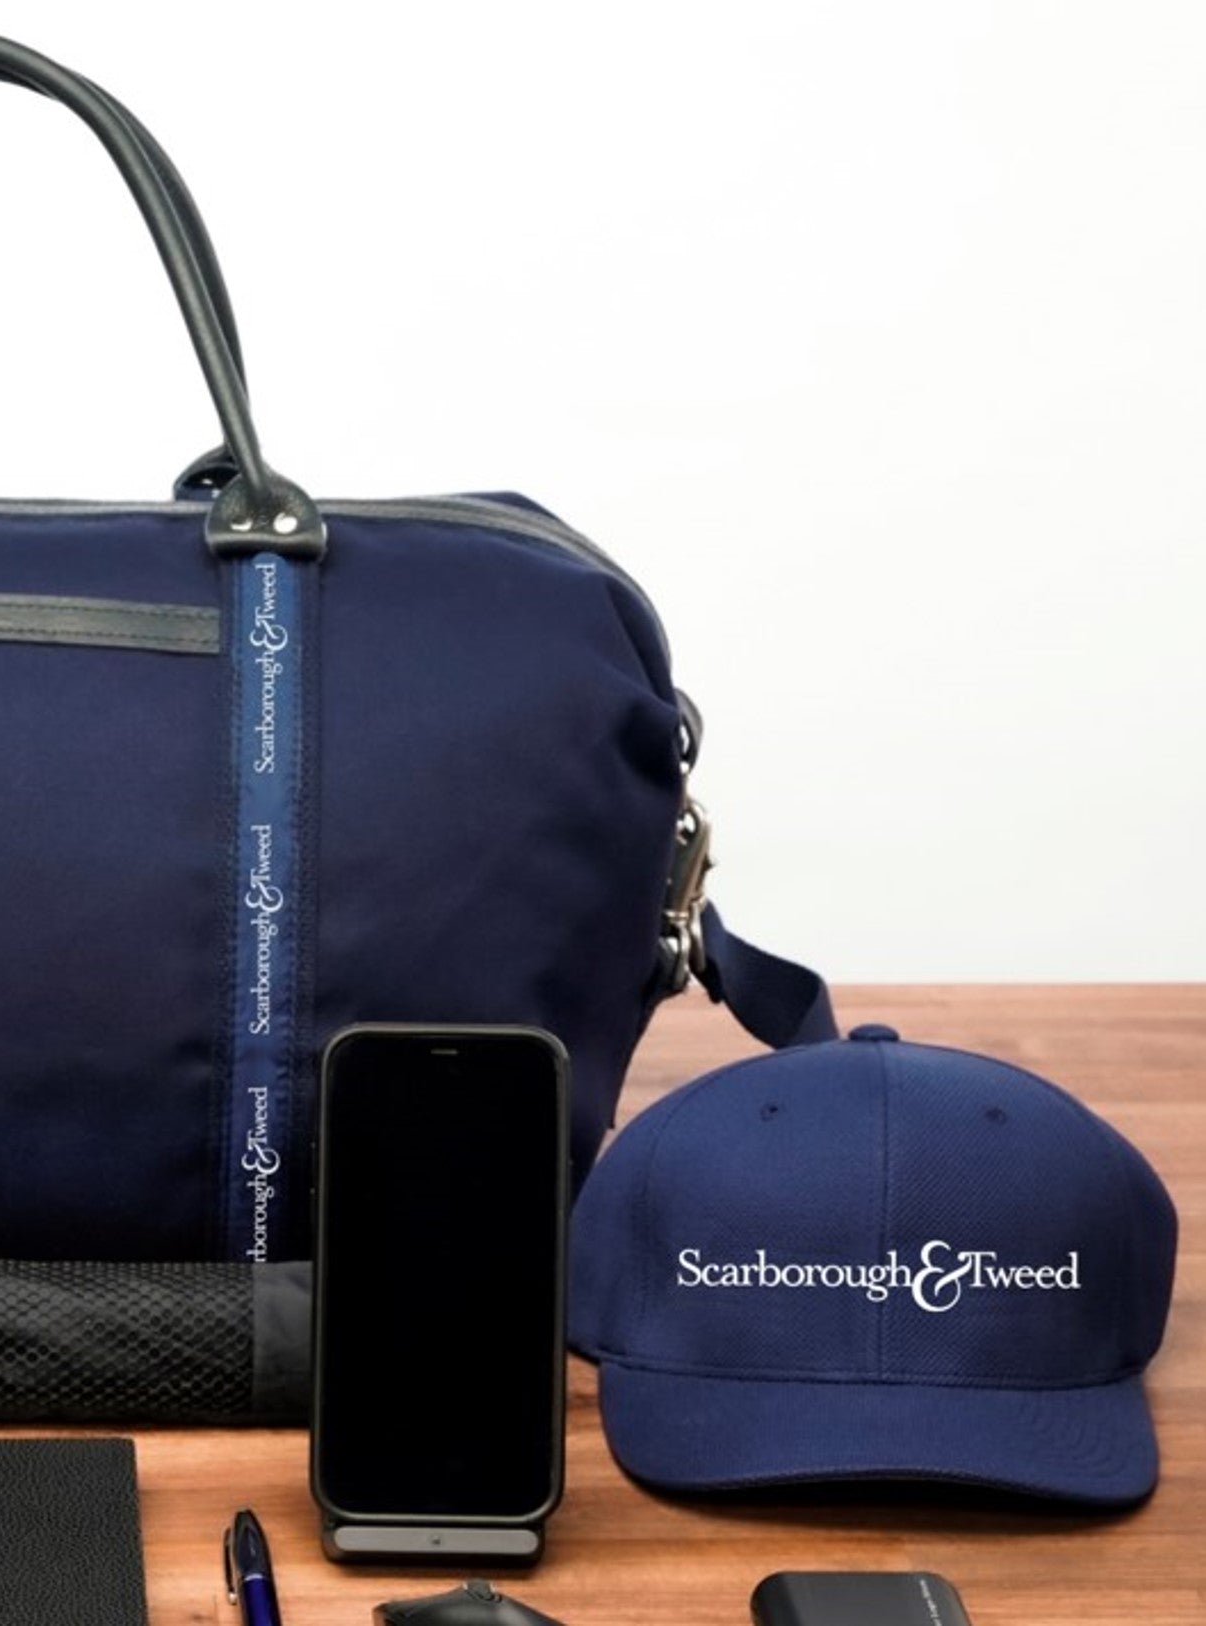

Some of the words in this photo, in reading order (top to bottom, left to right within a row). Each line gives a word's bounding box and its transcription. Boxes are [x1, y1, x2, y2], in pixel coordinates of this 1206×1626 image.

[250, 563, 288, 774] Scarborough&Tweed
[245, 825, 284, 1035] Scarborough&Tweed
[242, 1086, 280, 1263] rborough&Tweed
[677, 1240, 1082, 1313] Scarborough&Tweed
